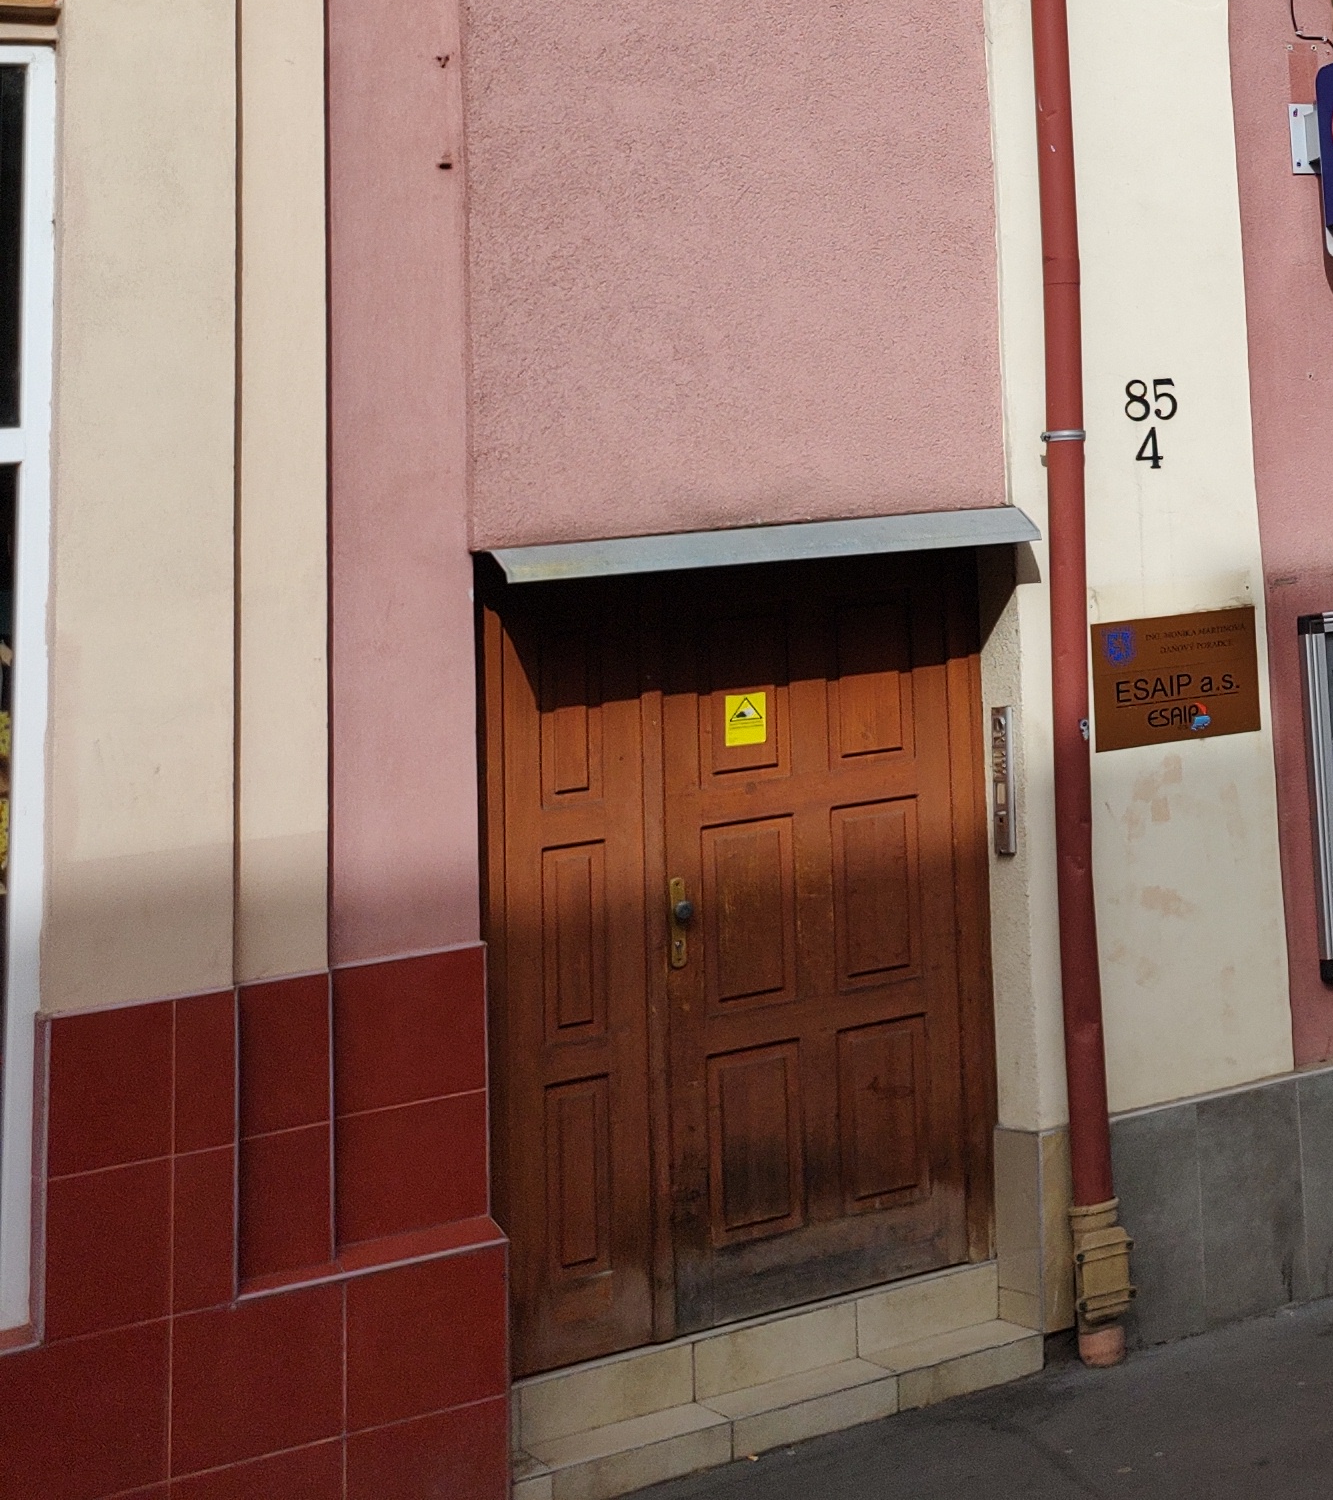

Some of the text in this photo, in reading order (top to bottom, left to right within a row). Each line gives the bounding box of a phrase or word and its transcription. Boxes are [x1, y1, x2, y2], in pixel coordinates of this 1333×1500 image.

[1124, 378, 1178, 422] 85
[1135, 426, 1164, 470] 4
[1116, 673, 1240, 703] ESAIP a.s.
[1148, 704, 1200, 727] ESAIP
